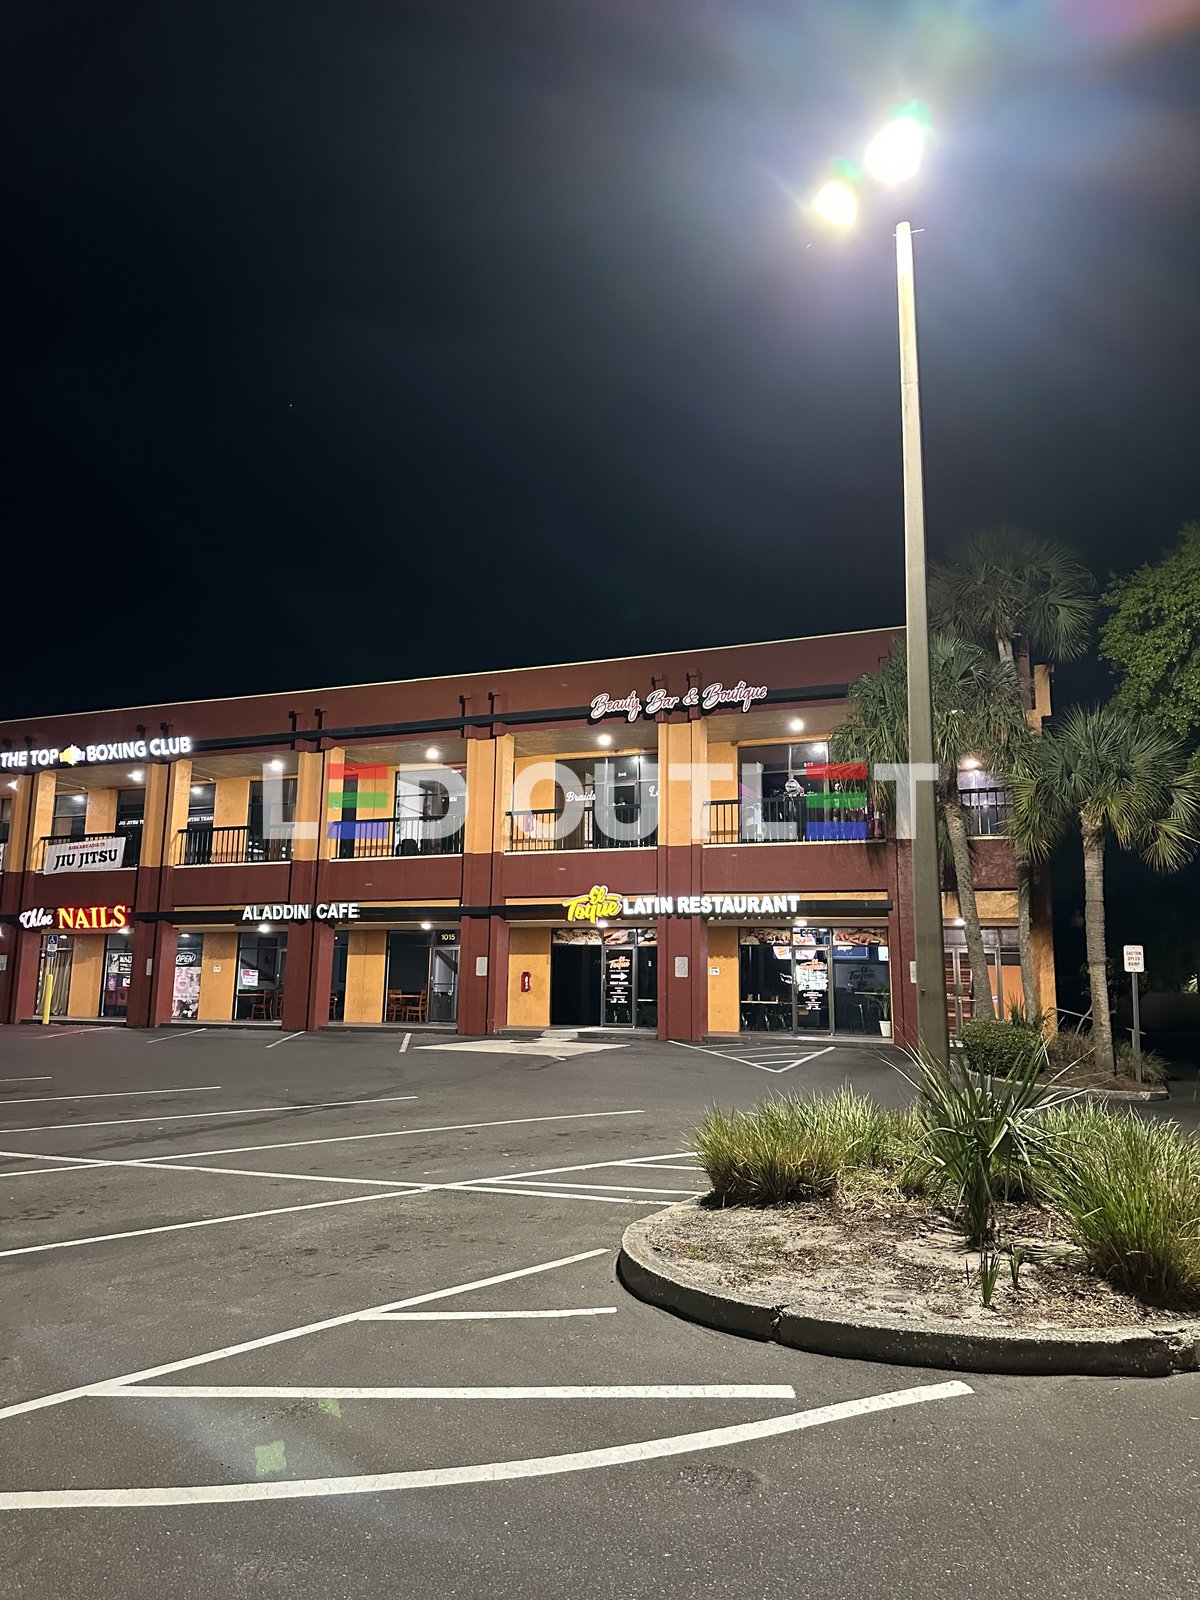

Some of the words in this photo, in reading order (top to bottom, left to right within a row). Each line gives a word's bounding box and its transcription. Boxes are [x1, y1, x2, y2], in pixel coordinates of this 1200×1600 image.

[590, 690, 642, 722] Beauty
[645, 689, 680, 714] Bar
[683, 687, 699, 705] &
[702, 680, 768, 713] Boutique
[0, 751, 27, 768] THE
[29, 748, 59, 766] TOP
[86, 740, 147, 762] BOXING
[149, 736, 192, 756] CLUB
[565, 790, 596, 802] Braids
[54, 854, 76, 870] JIU
[78, 849, 118, 868] JITSU
[588, 885, 608, 903] El
[241, 904, 312, 920] ALADDIN
[315, 903, 361, 919] CAFE
[563, 893, 623, 924] Toque
[622, 897, 674, 915] LATIN
[677, 895, 800, 915] RESTAURANT
[57, 905, 126, 929] NAILS
[441, 933, 456, 941] 1015
[176, 954, 194, 963] OPEN
